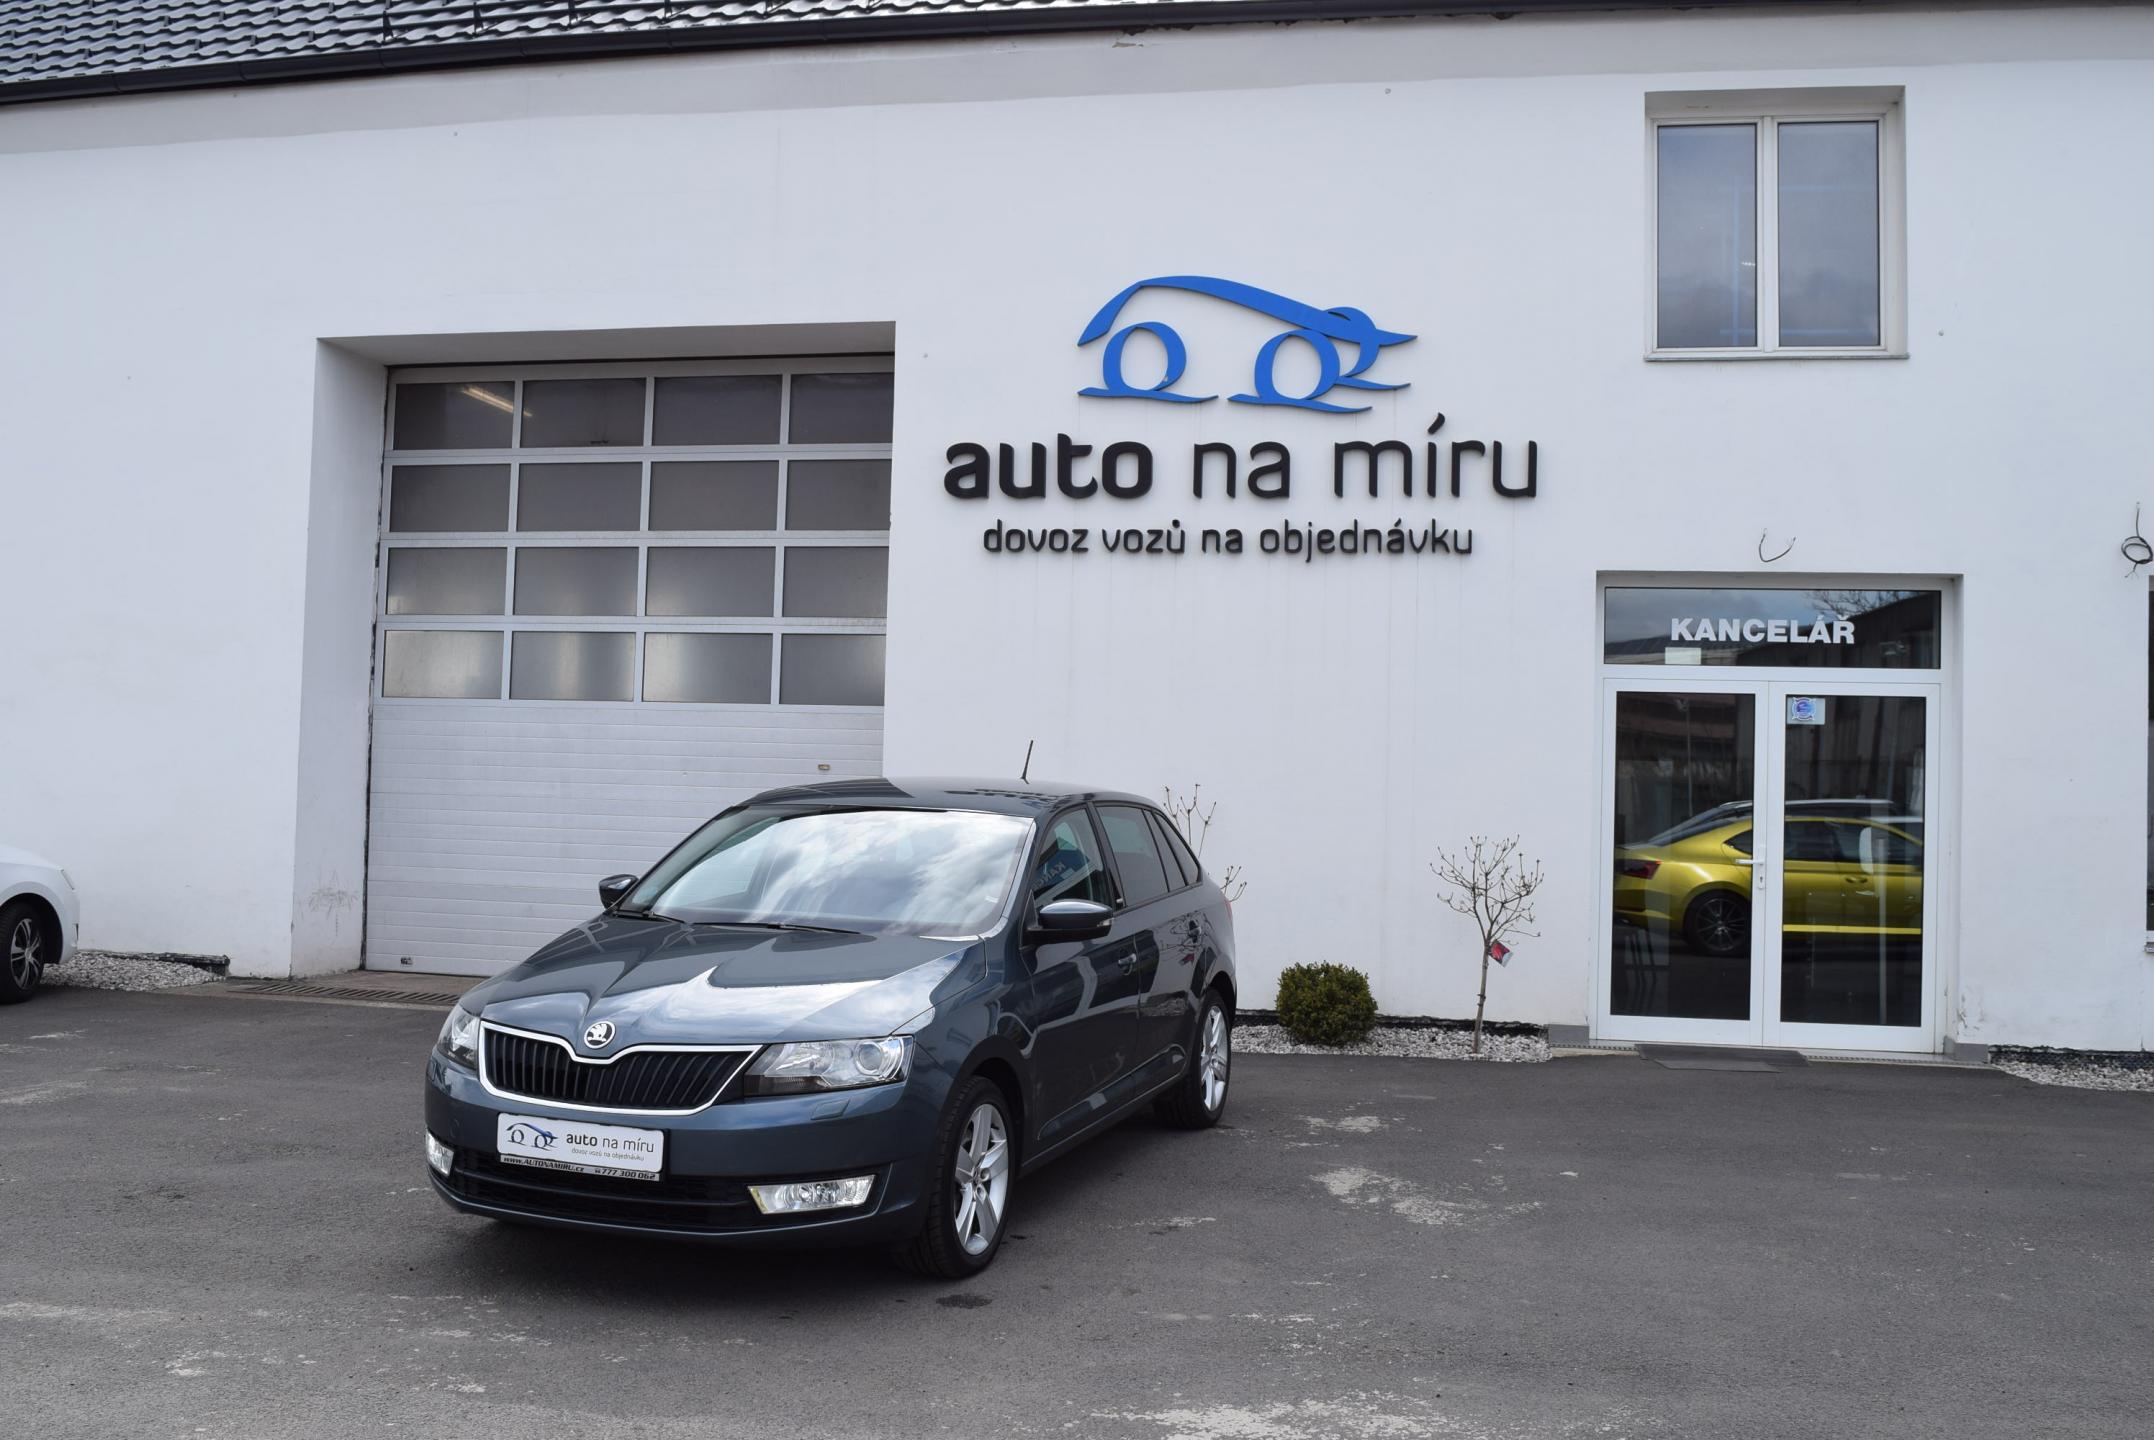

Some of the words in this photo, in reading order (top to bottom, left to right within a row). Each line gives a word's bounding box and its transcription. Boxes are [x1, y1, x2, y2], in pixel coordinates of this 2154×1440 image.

[943, 433, 1154, 501] auto
[1192, 441, 1291, 500] na
[1333, 412, 1538, 501] míru
[983, 518, 1089, 555] dovoz
[1101, 519, 1186, 556] vozů
[1201, 528, 1243, 554] na
[1259, 517, 1473, 564] objednávku
[1671, 614, 1855, 644] KANCELÁŘ
[566, 1133, 598, 1147] auto
[602, 1137, 619, 1149] na
[623, 1137, 655, 1153] míru
[601, 1168, 618, 1177] 777
[619, 1170, 637, 1179] 300
